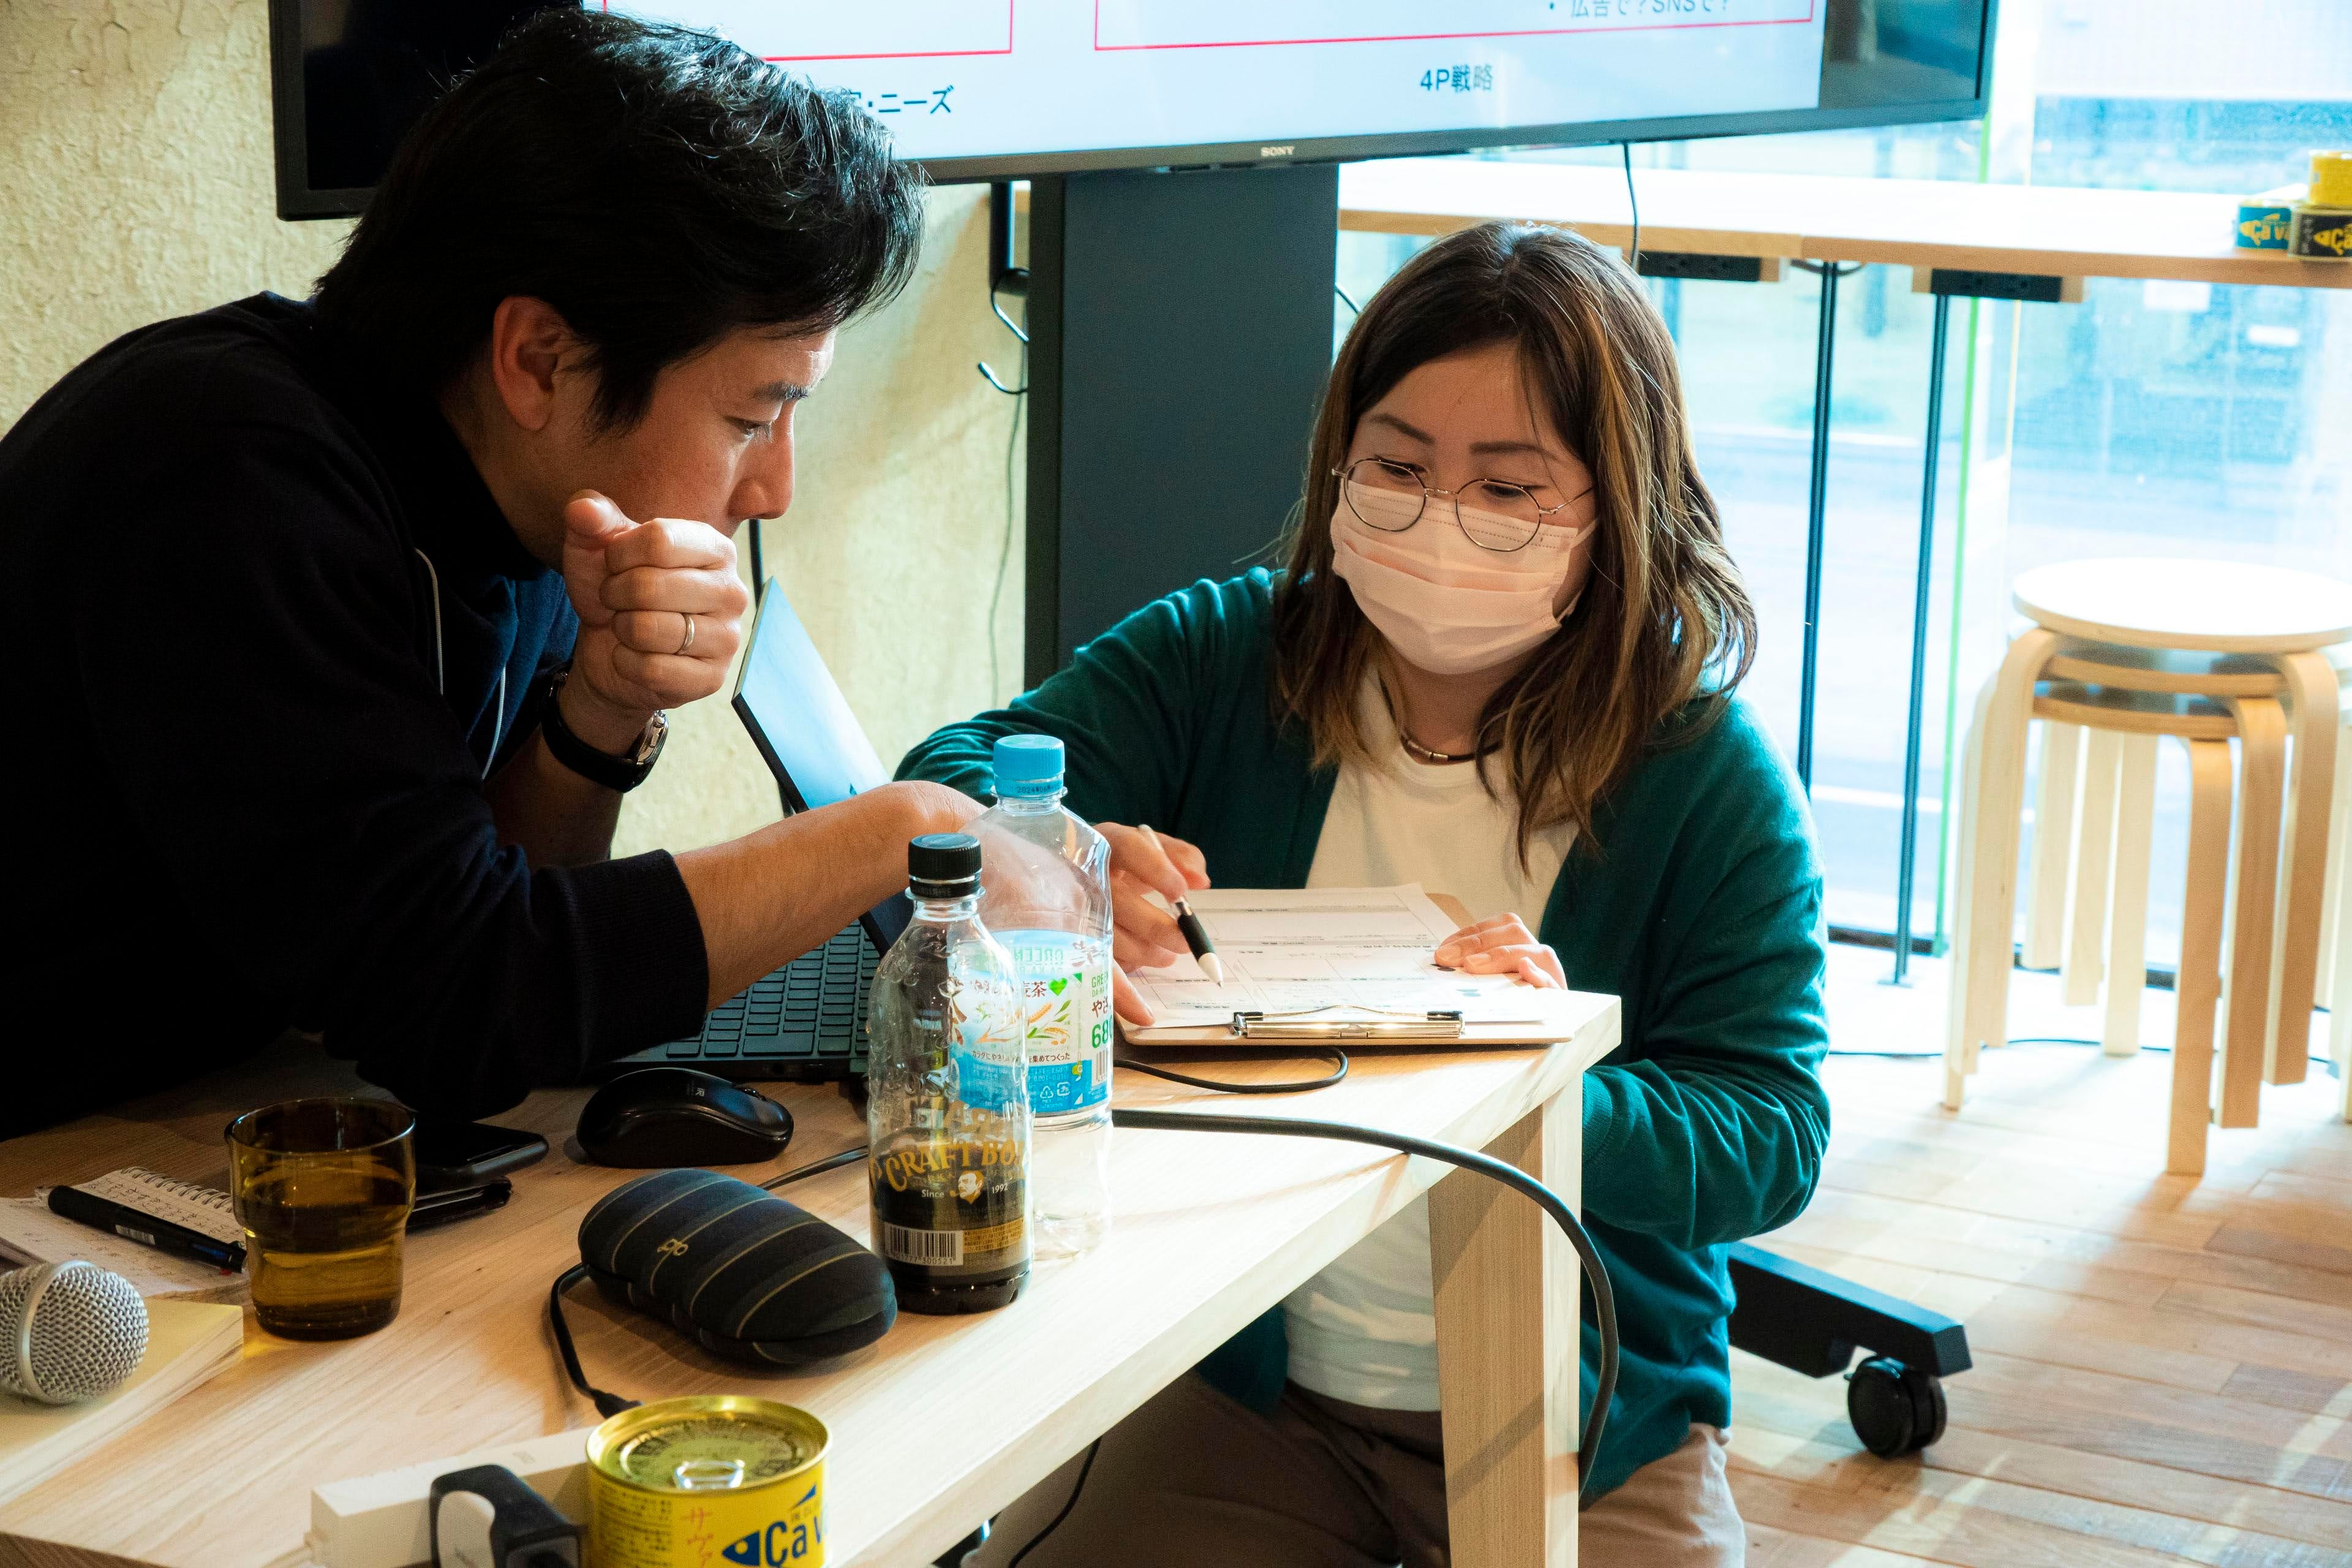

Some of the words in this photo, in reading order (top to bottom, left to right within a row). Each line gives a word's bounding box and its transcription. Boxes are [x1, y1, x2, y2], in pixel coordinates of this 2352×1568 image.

[1261, 146, 1294, 156] SONY
[886, 1140, 970, 1191] CRAFT
[921, 1189, 945, 1198] Since
[992, 1183, 1009, 1194] 1992
